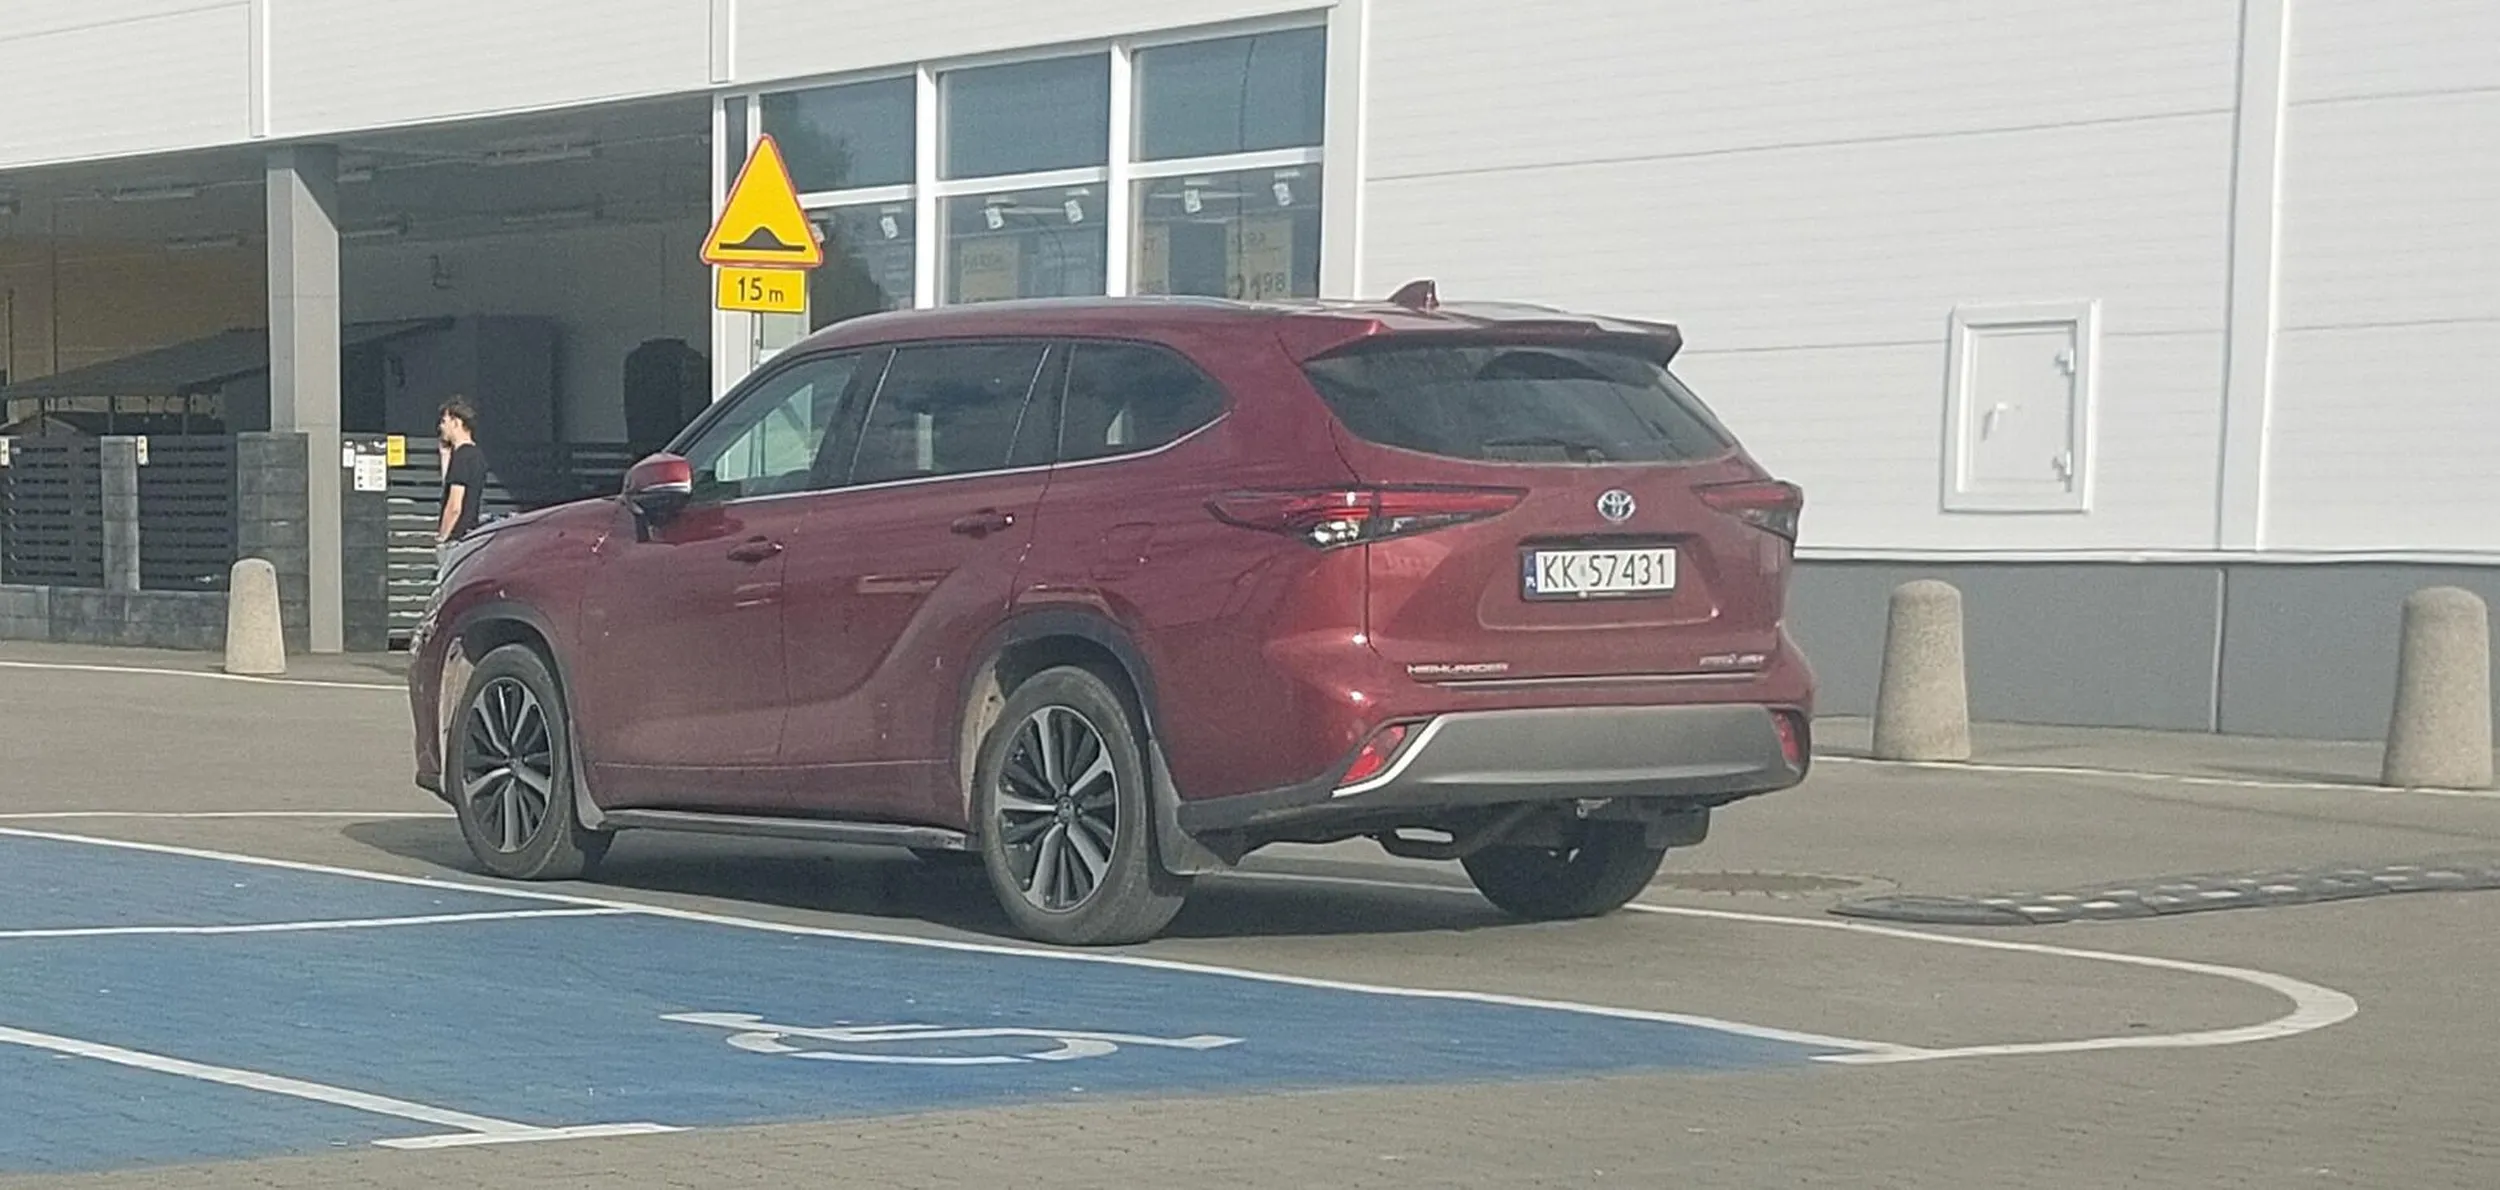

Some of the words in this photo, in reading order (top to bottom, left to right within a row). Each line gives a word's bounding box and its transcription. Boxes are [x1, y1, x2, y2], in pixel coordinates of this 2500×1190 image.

[738, 277, 763, 302] 15
[768, 289, 784, 303] m
[1543, 555, 1578, 588] KK
[1589, 553, 1665, 587] 57431
